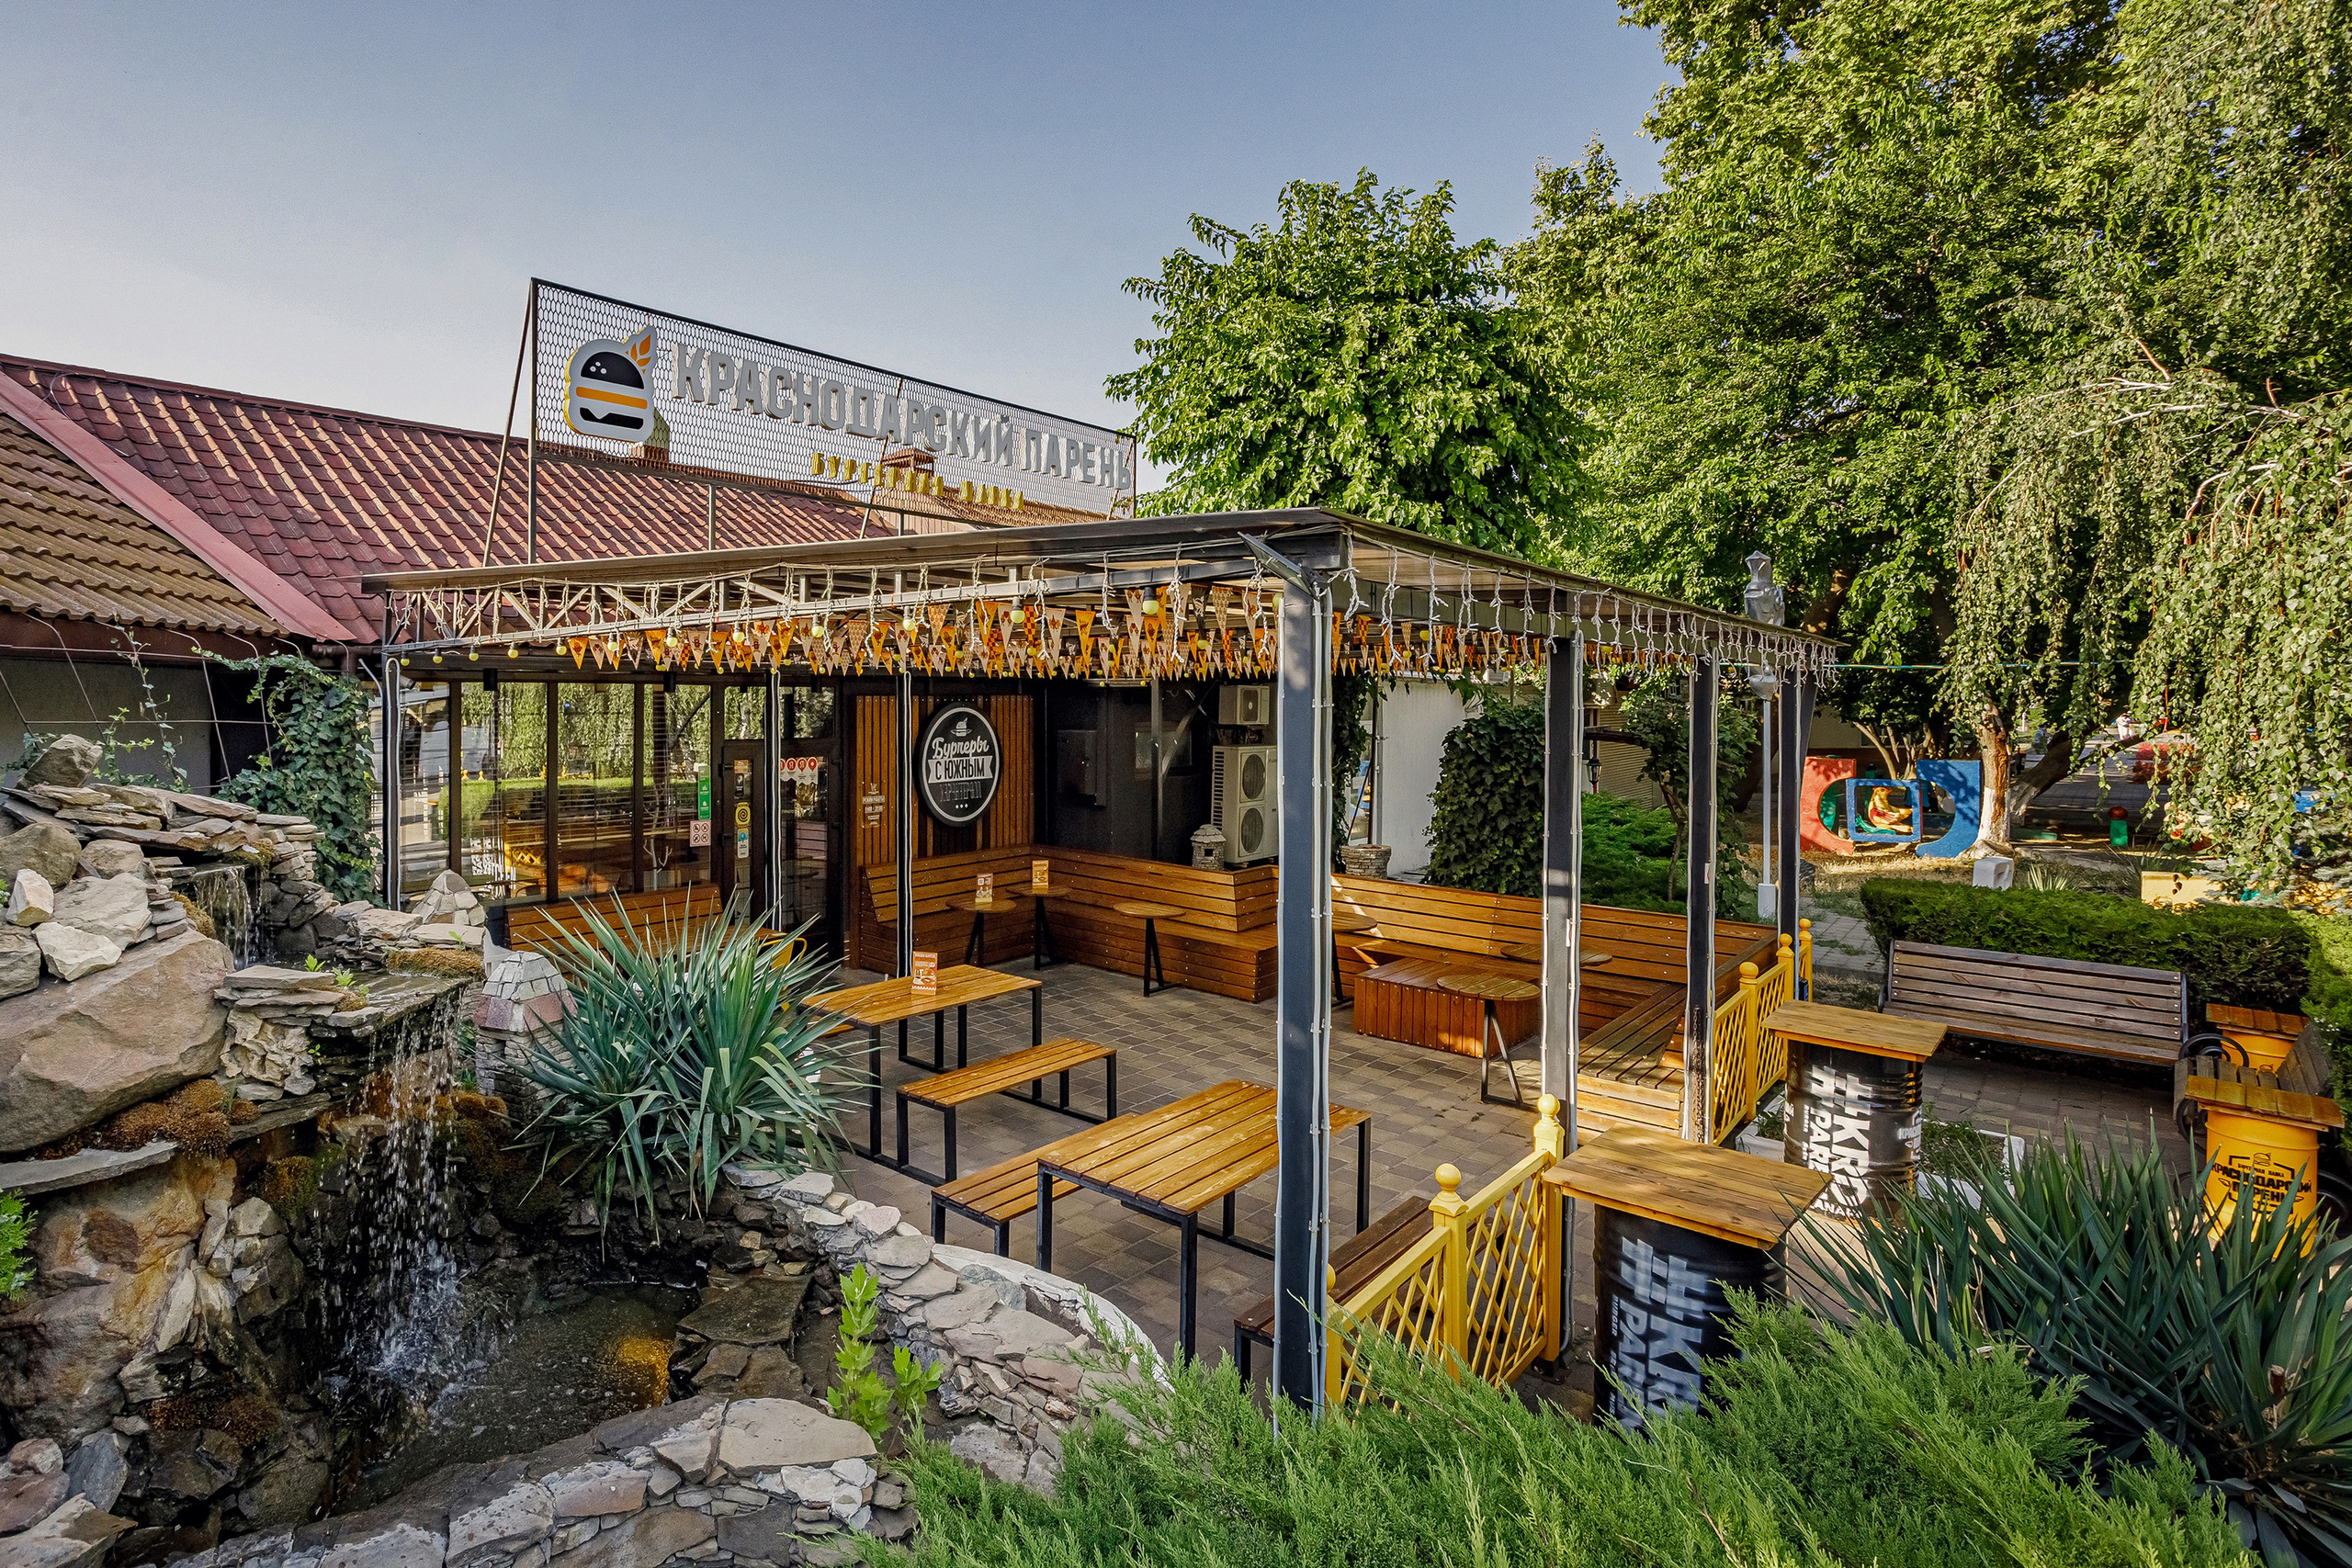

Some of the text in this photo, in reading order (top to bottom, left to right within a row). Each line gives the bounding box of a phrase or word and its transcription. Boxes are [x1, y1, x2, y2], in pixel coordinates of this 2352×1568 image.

[672, 342, 1131, 491] КРАСНОДАРСКИЙ ПАРЕНЬ
[932, 736, 989, 760] Бургеры
[935, 760, 985, 781] С ЮЖНЫМ
